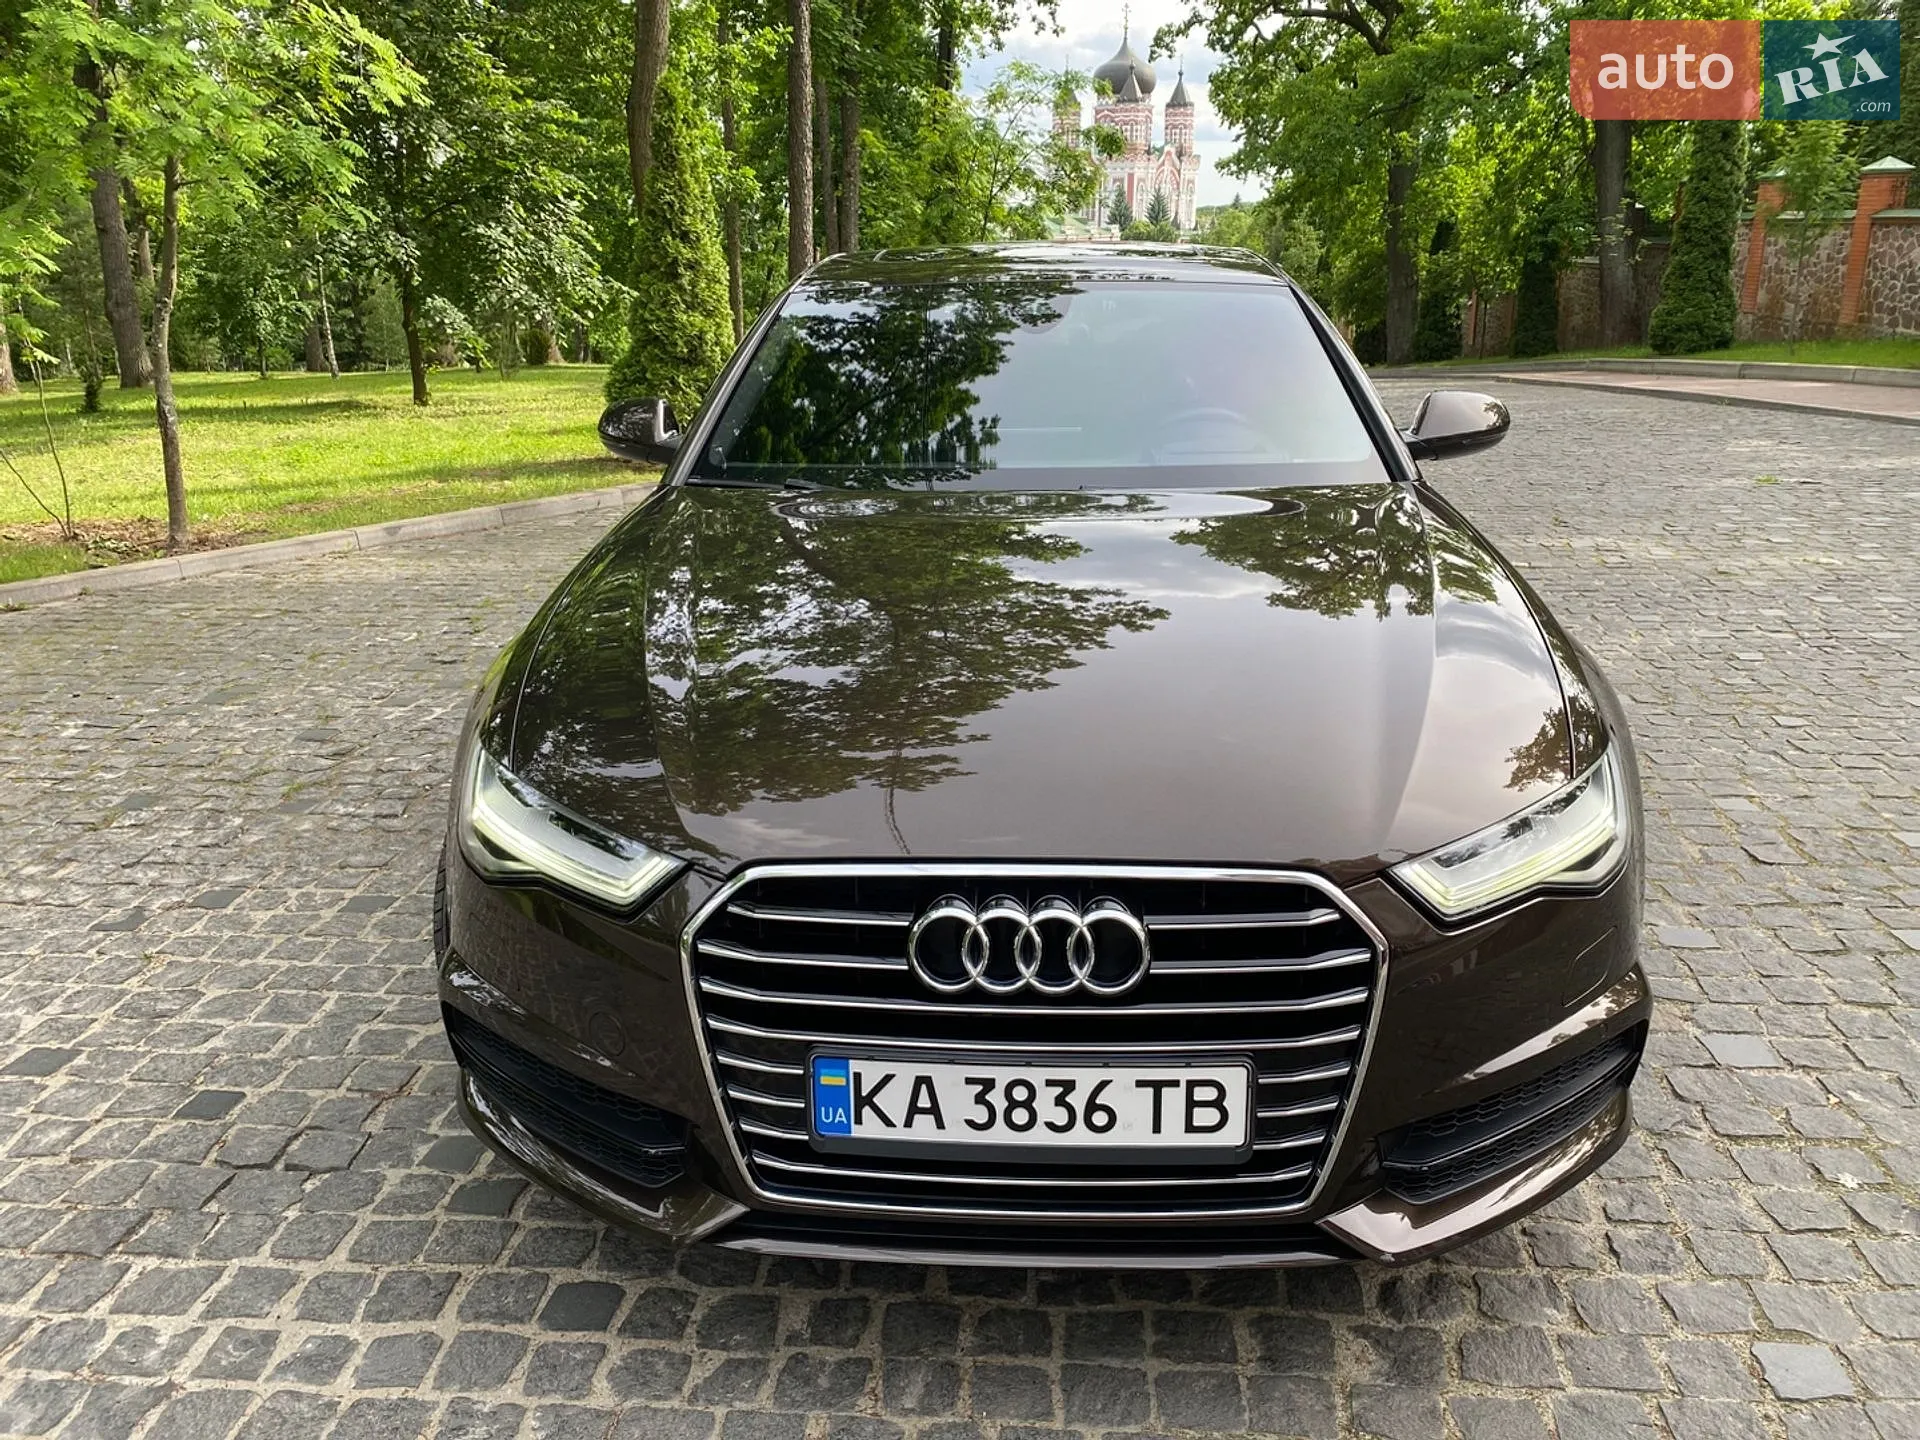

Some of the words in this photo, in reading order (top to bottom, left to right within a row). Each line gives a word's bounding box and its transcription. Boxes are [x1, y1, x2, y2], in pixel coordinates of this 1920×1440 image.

[821, 1107, 848, 1124] UA
[853, 1071, 946, 1130] KA
[964, 1077, 1118, 1134] 3836
[1135, 1079, 1229, 1134] TB
